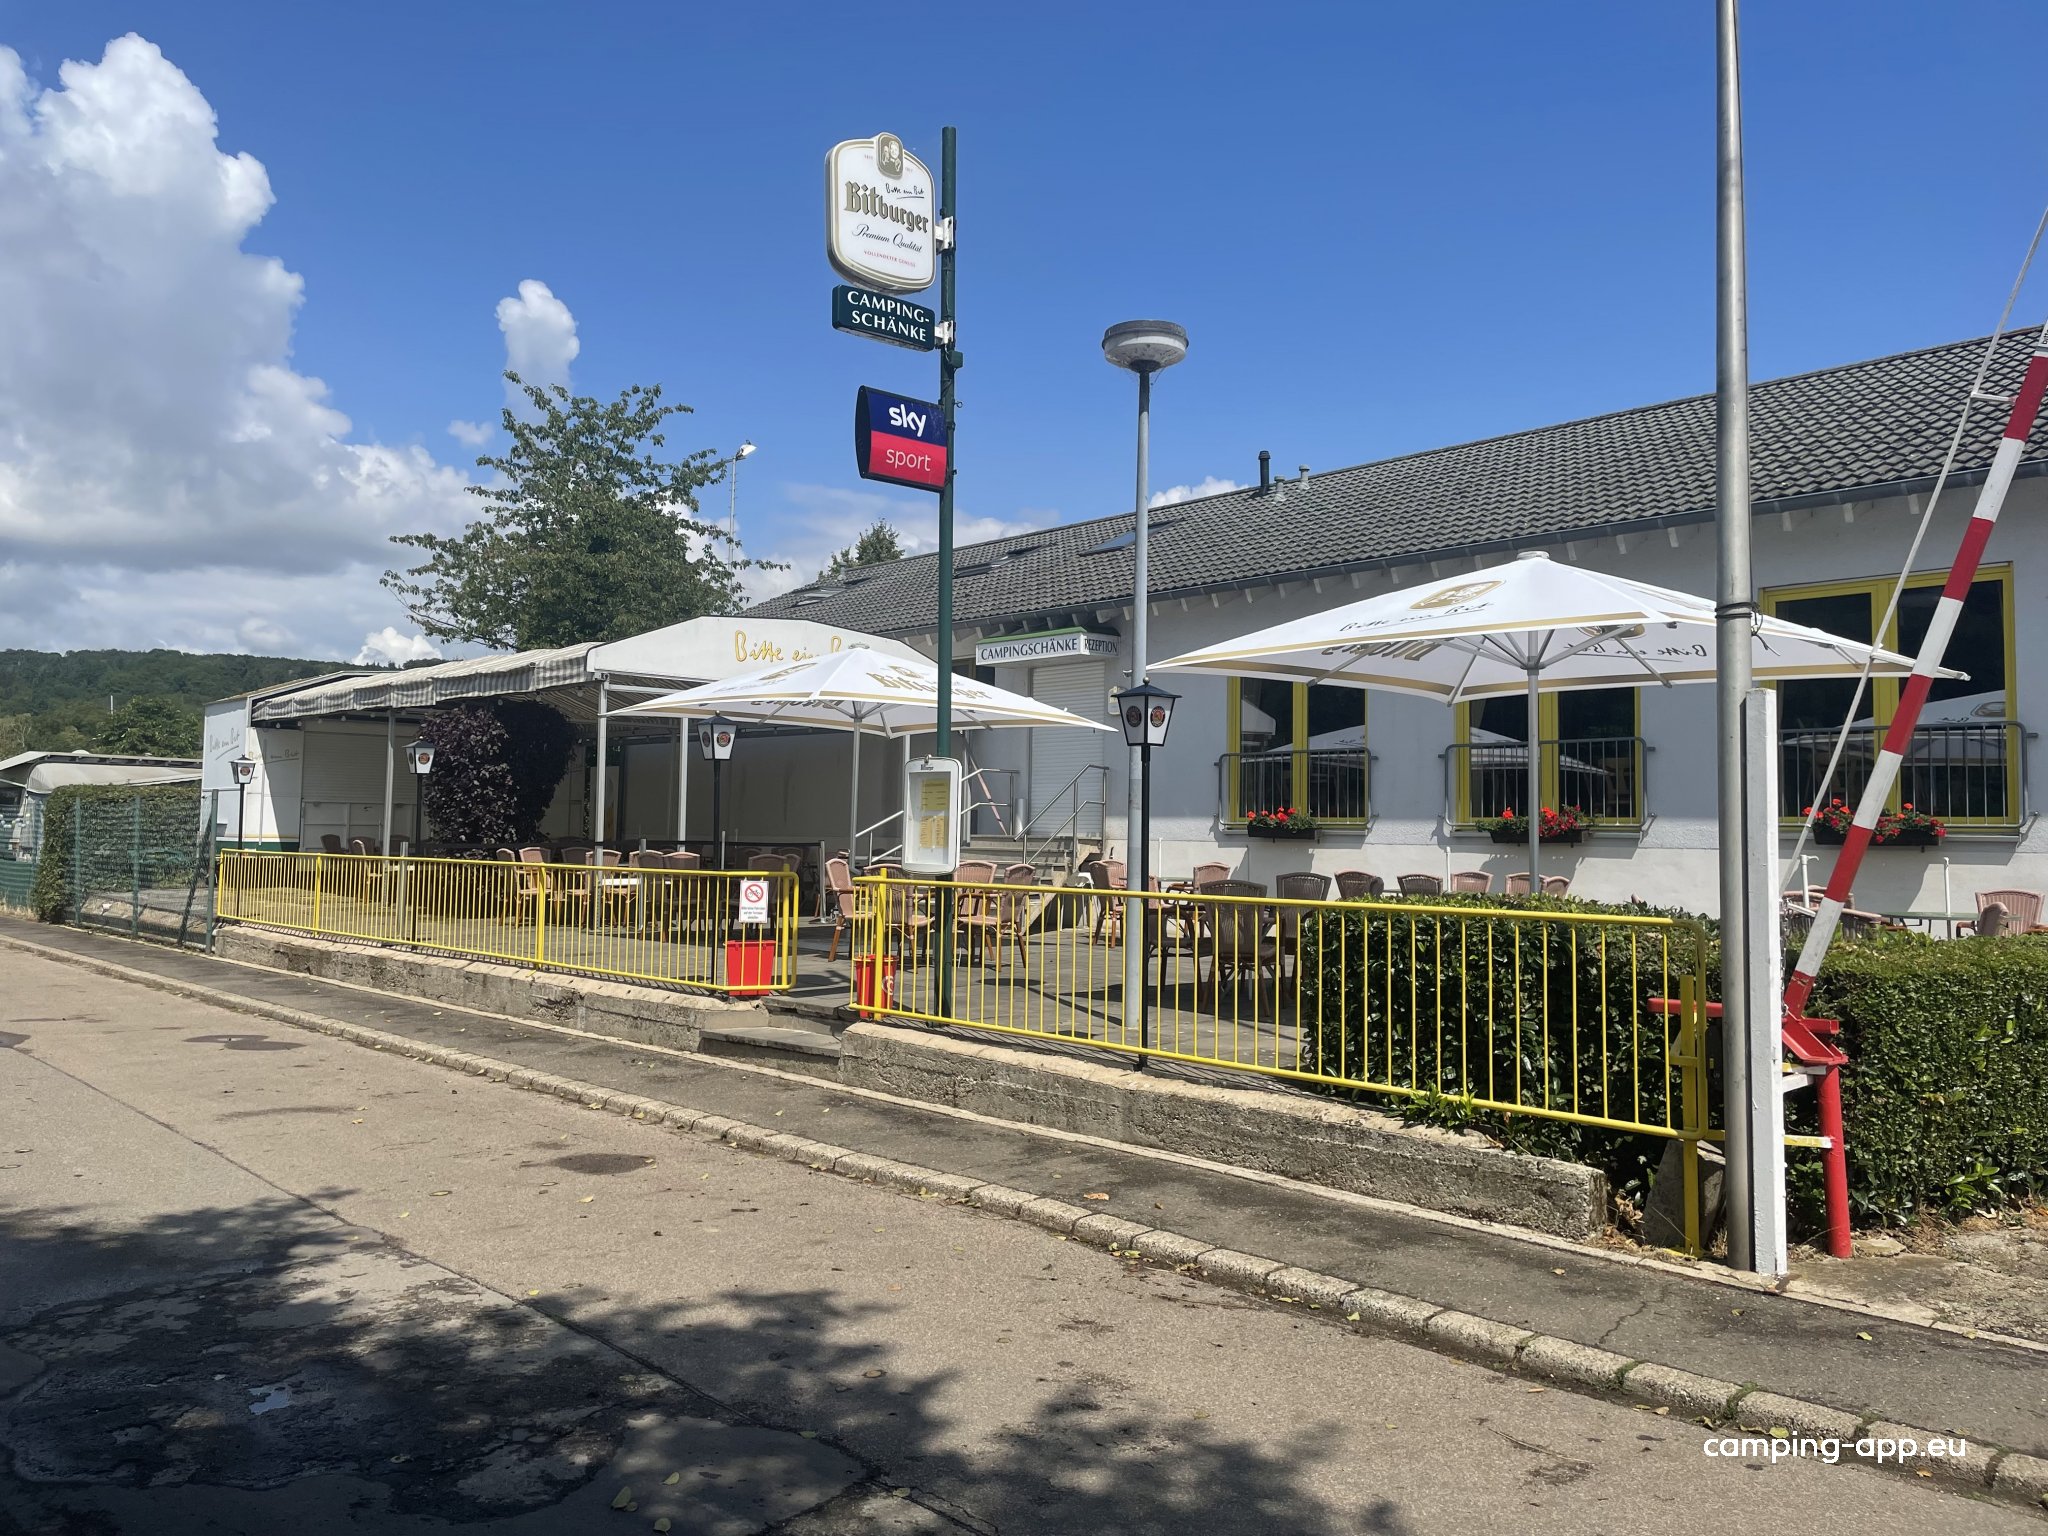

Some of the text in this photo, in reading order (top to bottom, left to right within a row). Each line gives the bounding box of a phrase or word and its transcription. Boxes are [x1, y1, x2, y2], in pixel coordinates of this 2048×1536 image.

[844, 181, 929, 233] Bitburger
[852, 224, 890, 243] Premium
[847, 290, 930, 323] CAMPING-
[852, 310, 926, 342] SCHÄNKE
[888, 403, 927, 437] sky
[886, 449, 931, 472] sport
[735, 630, 783, 662] Bitte
[981, 638, 1077, 660] CAMPINGSCHÄNKE
[1084, 638, 1118, 653] REZEPTION
